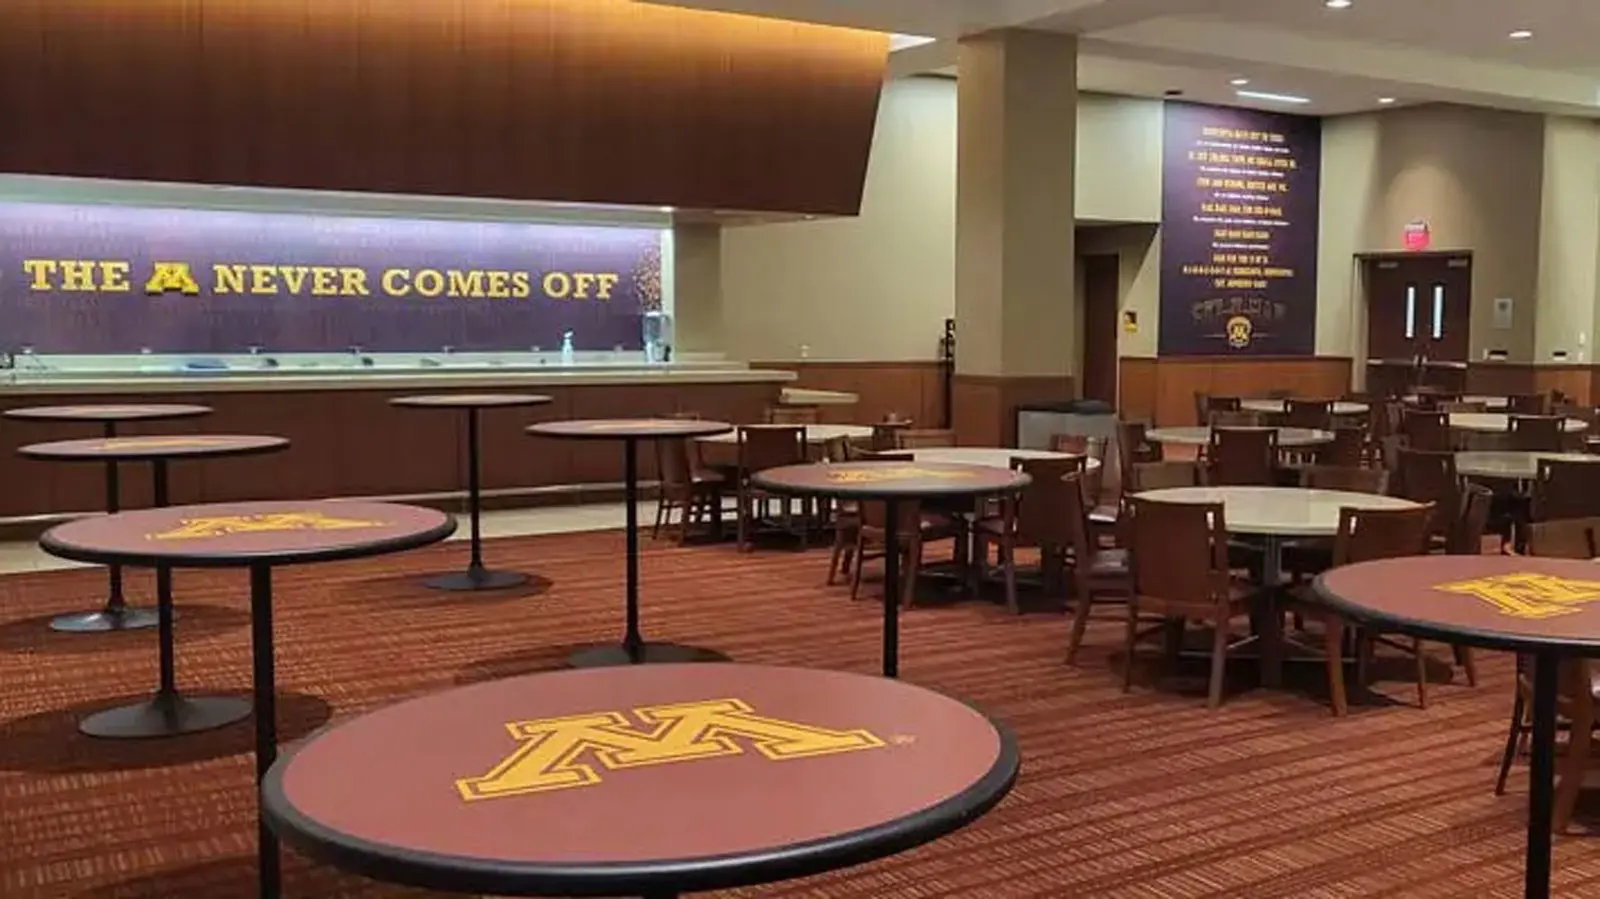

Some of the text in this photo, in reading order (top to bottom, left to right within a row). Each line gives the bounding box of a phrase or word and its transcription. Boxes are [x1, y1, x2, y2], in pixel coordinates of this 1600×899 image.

[23, 259, 131, 292] THE
[213, 264, 370, 297] NEVER
[382, 268, 531, 298] COMES
[543, 271, 619, 299] OFF
[455, 697, 886, 803] M
